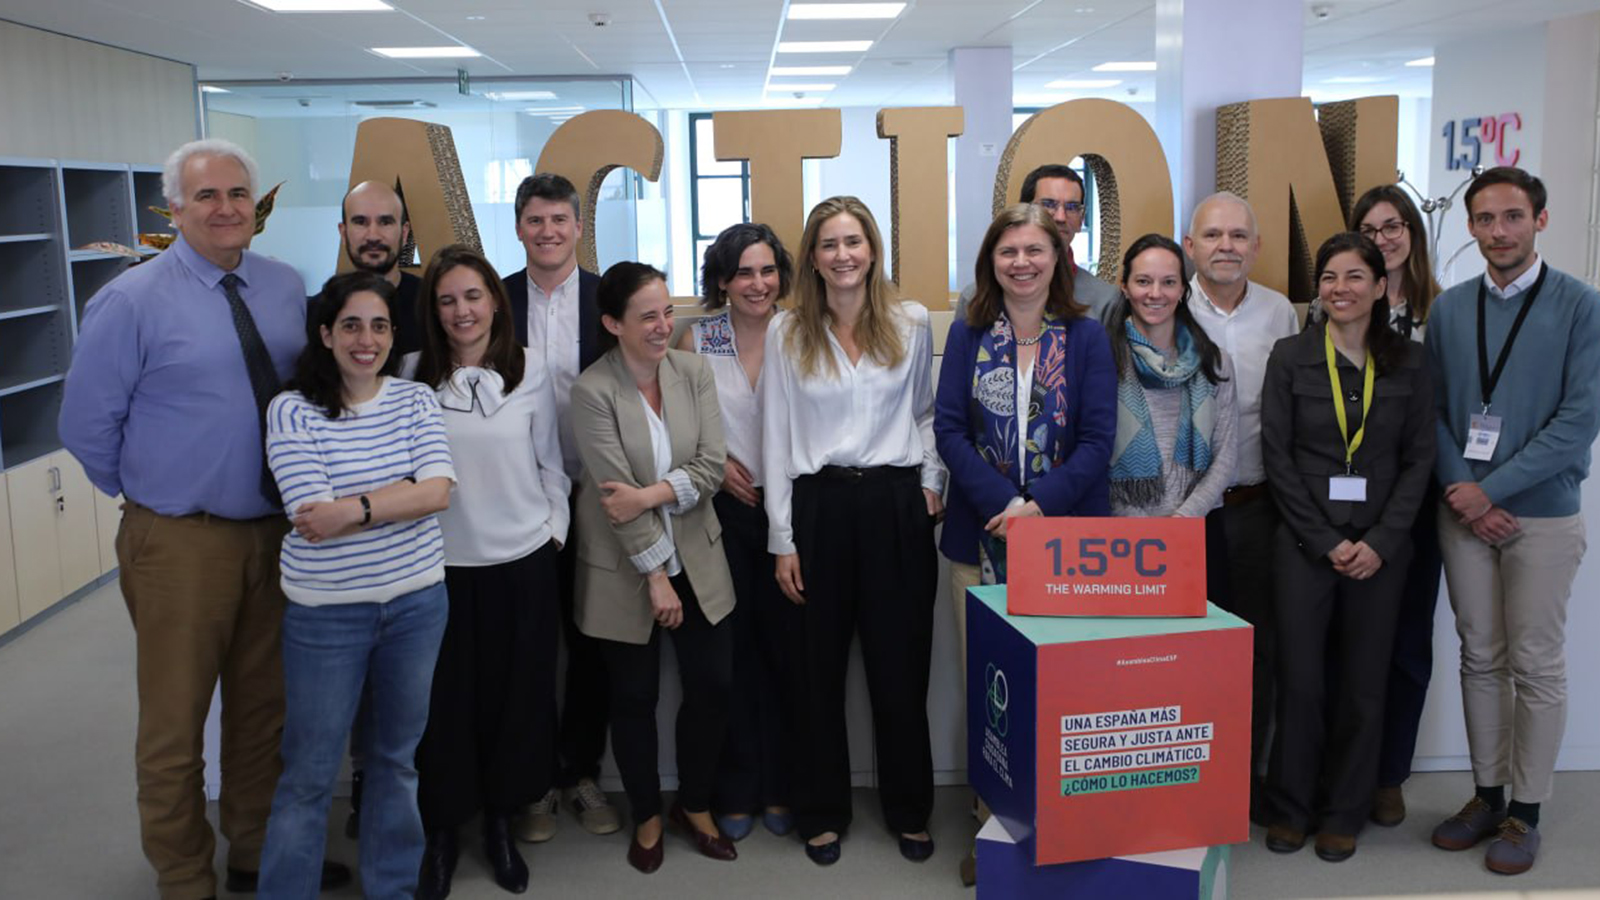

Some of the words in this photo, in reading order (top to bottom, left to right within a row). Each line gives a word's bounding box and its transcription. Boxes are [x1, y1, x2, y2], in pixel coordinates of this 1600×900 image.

[336, 97, 1399, 311] ACTION
[1045, 584, 1070, 595] THE
[1073, 584, 1131, 595] WARMING
[1135, 584, 1167, 595] LIMIT
[1065, 717, 1092, 731] UNA
[1095, 710, 1147, 728] ESPAÑA
[1150, 706, 1177, 722] MÁS
[1064, 735, 1116, 752] SEGURA
[1119, 734, 1128, 746] Y
[1131, 730, 1173, 746] JUSTA
[1176, 725, 1209, 740] ANTE
[1064, 760, 1080, 772] EL
[1084, 754, 1133, 770] CAMBIO
[1135, 747, 1206, 766] CLIMÁTICO.
[1064, 776, 1108, 796] ¿CÓMO
[1111, 775, 1128, 788] LO
[1130, 767, 1198, 786] HACEMOS?
